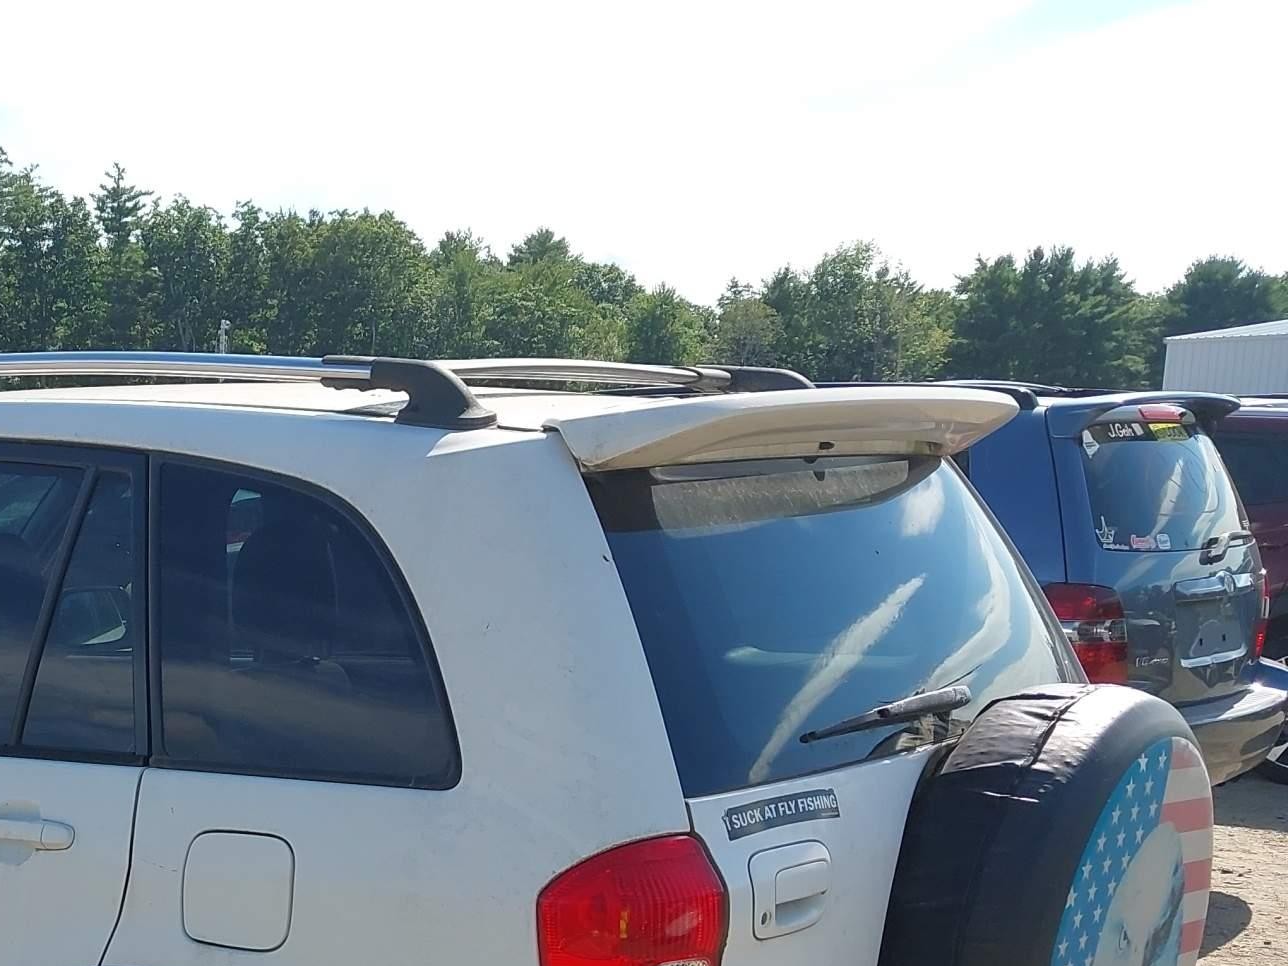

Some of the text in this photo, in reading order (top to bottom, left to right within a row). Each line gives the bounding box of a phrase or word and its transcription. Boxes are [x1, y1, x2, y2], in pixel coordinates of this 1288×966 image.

[731, 807, 764, 830] SUCK
[764, 803, 777, 819] AT
[778, 799, 797, 816] FLY
[797, 794, 836, 813] FISHING
